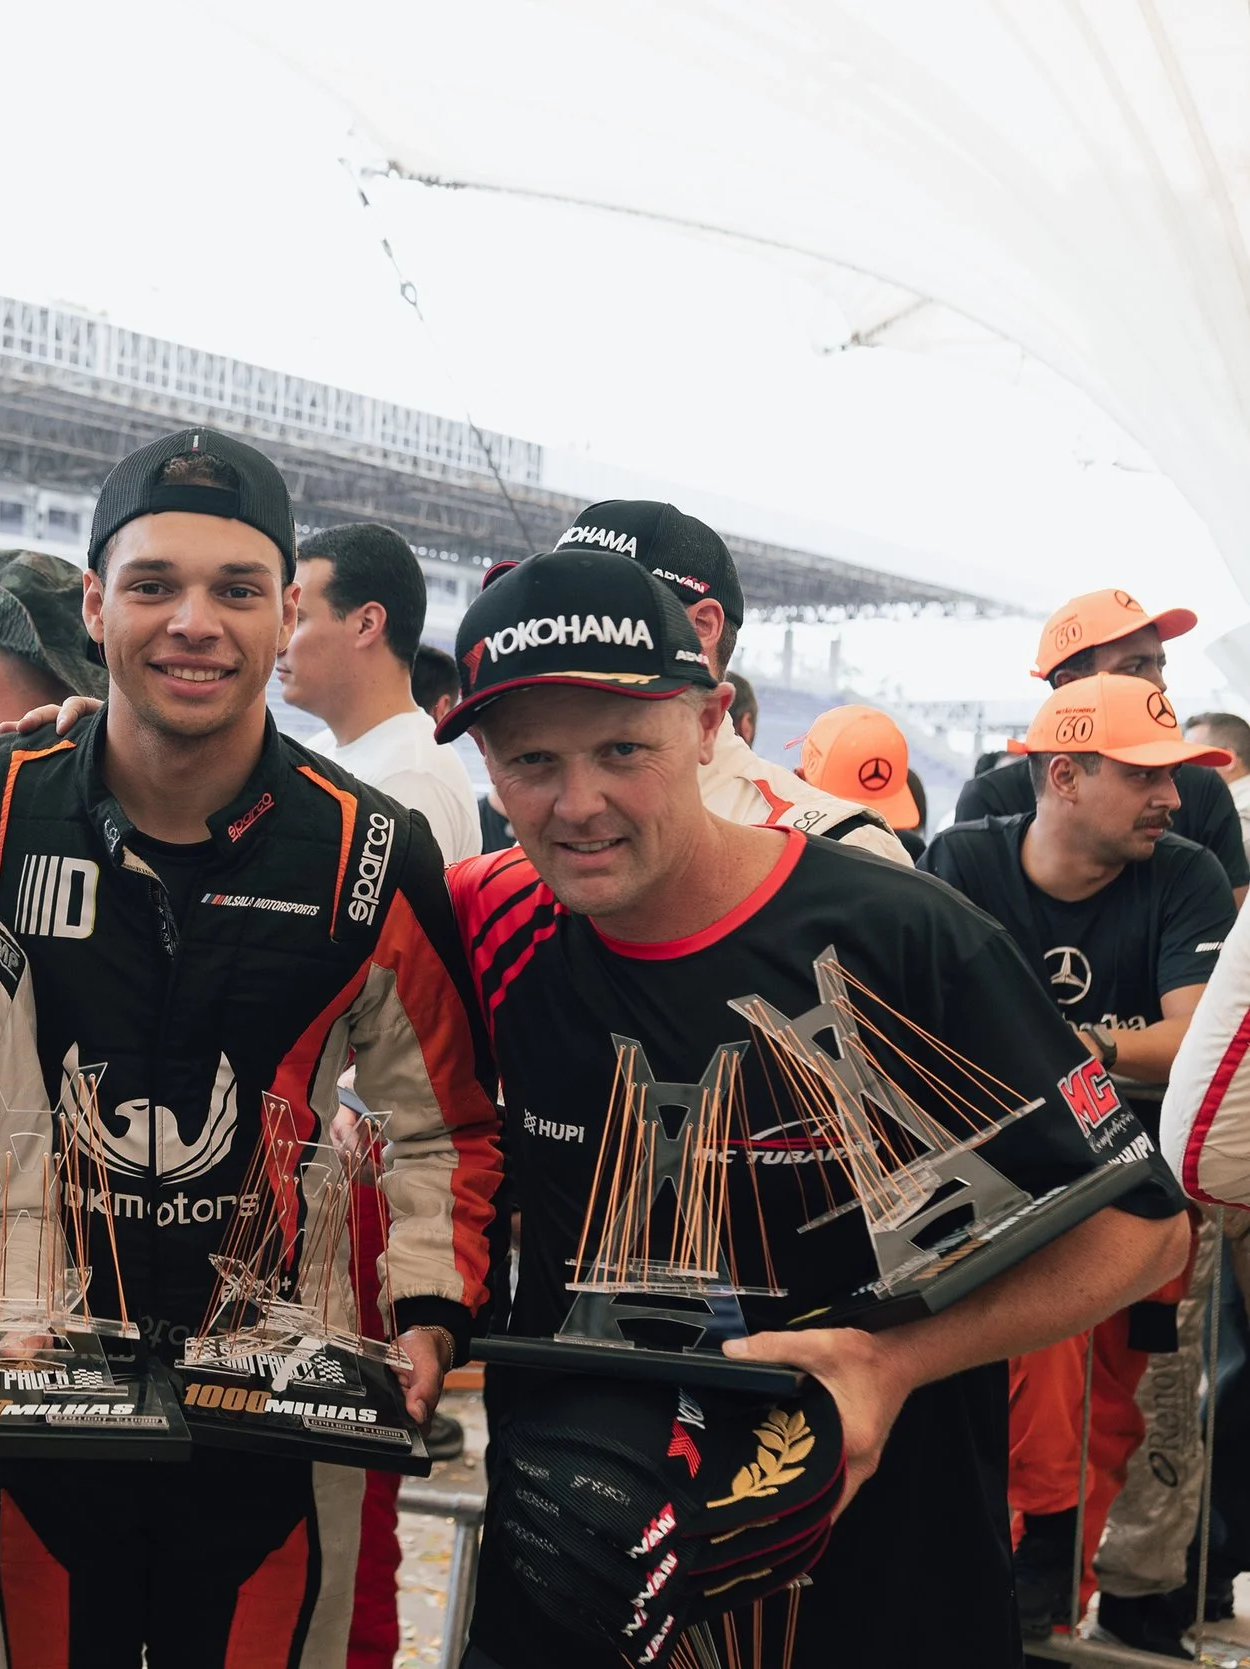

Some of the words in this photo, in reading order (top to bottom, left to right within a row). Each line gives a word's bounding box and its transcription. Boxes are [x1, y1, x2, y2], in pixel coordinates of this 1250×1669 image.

[652, 567, 706, 594] ADVAN
[485, 613, 654, 663] YOKOHAMA
[1054, 620, 1083, 653] 60
[1055, 714, 1094, 745] 60
[228, 792, 275, 843] sparco
[348, 812, 393, 925] sparco
[253, 898, 321, 917] MOTORSPORTS
[1057, 1056, 1122, 1139] MG
[538, 1120, 586, 1144] HUPI
